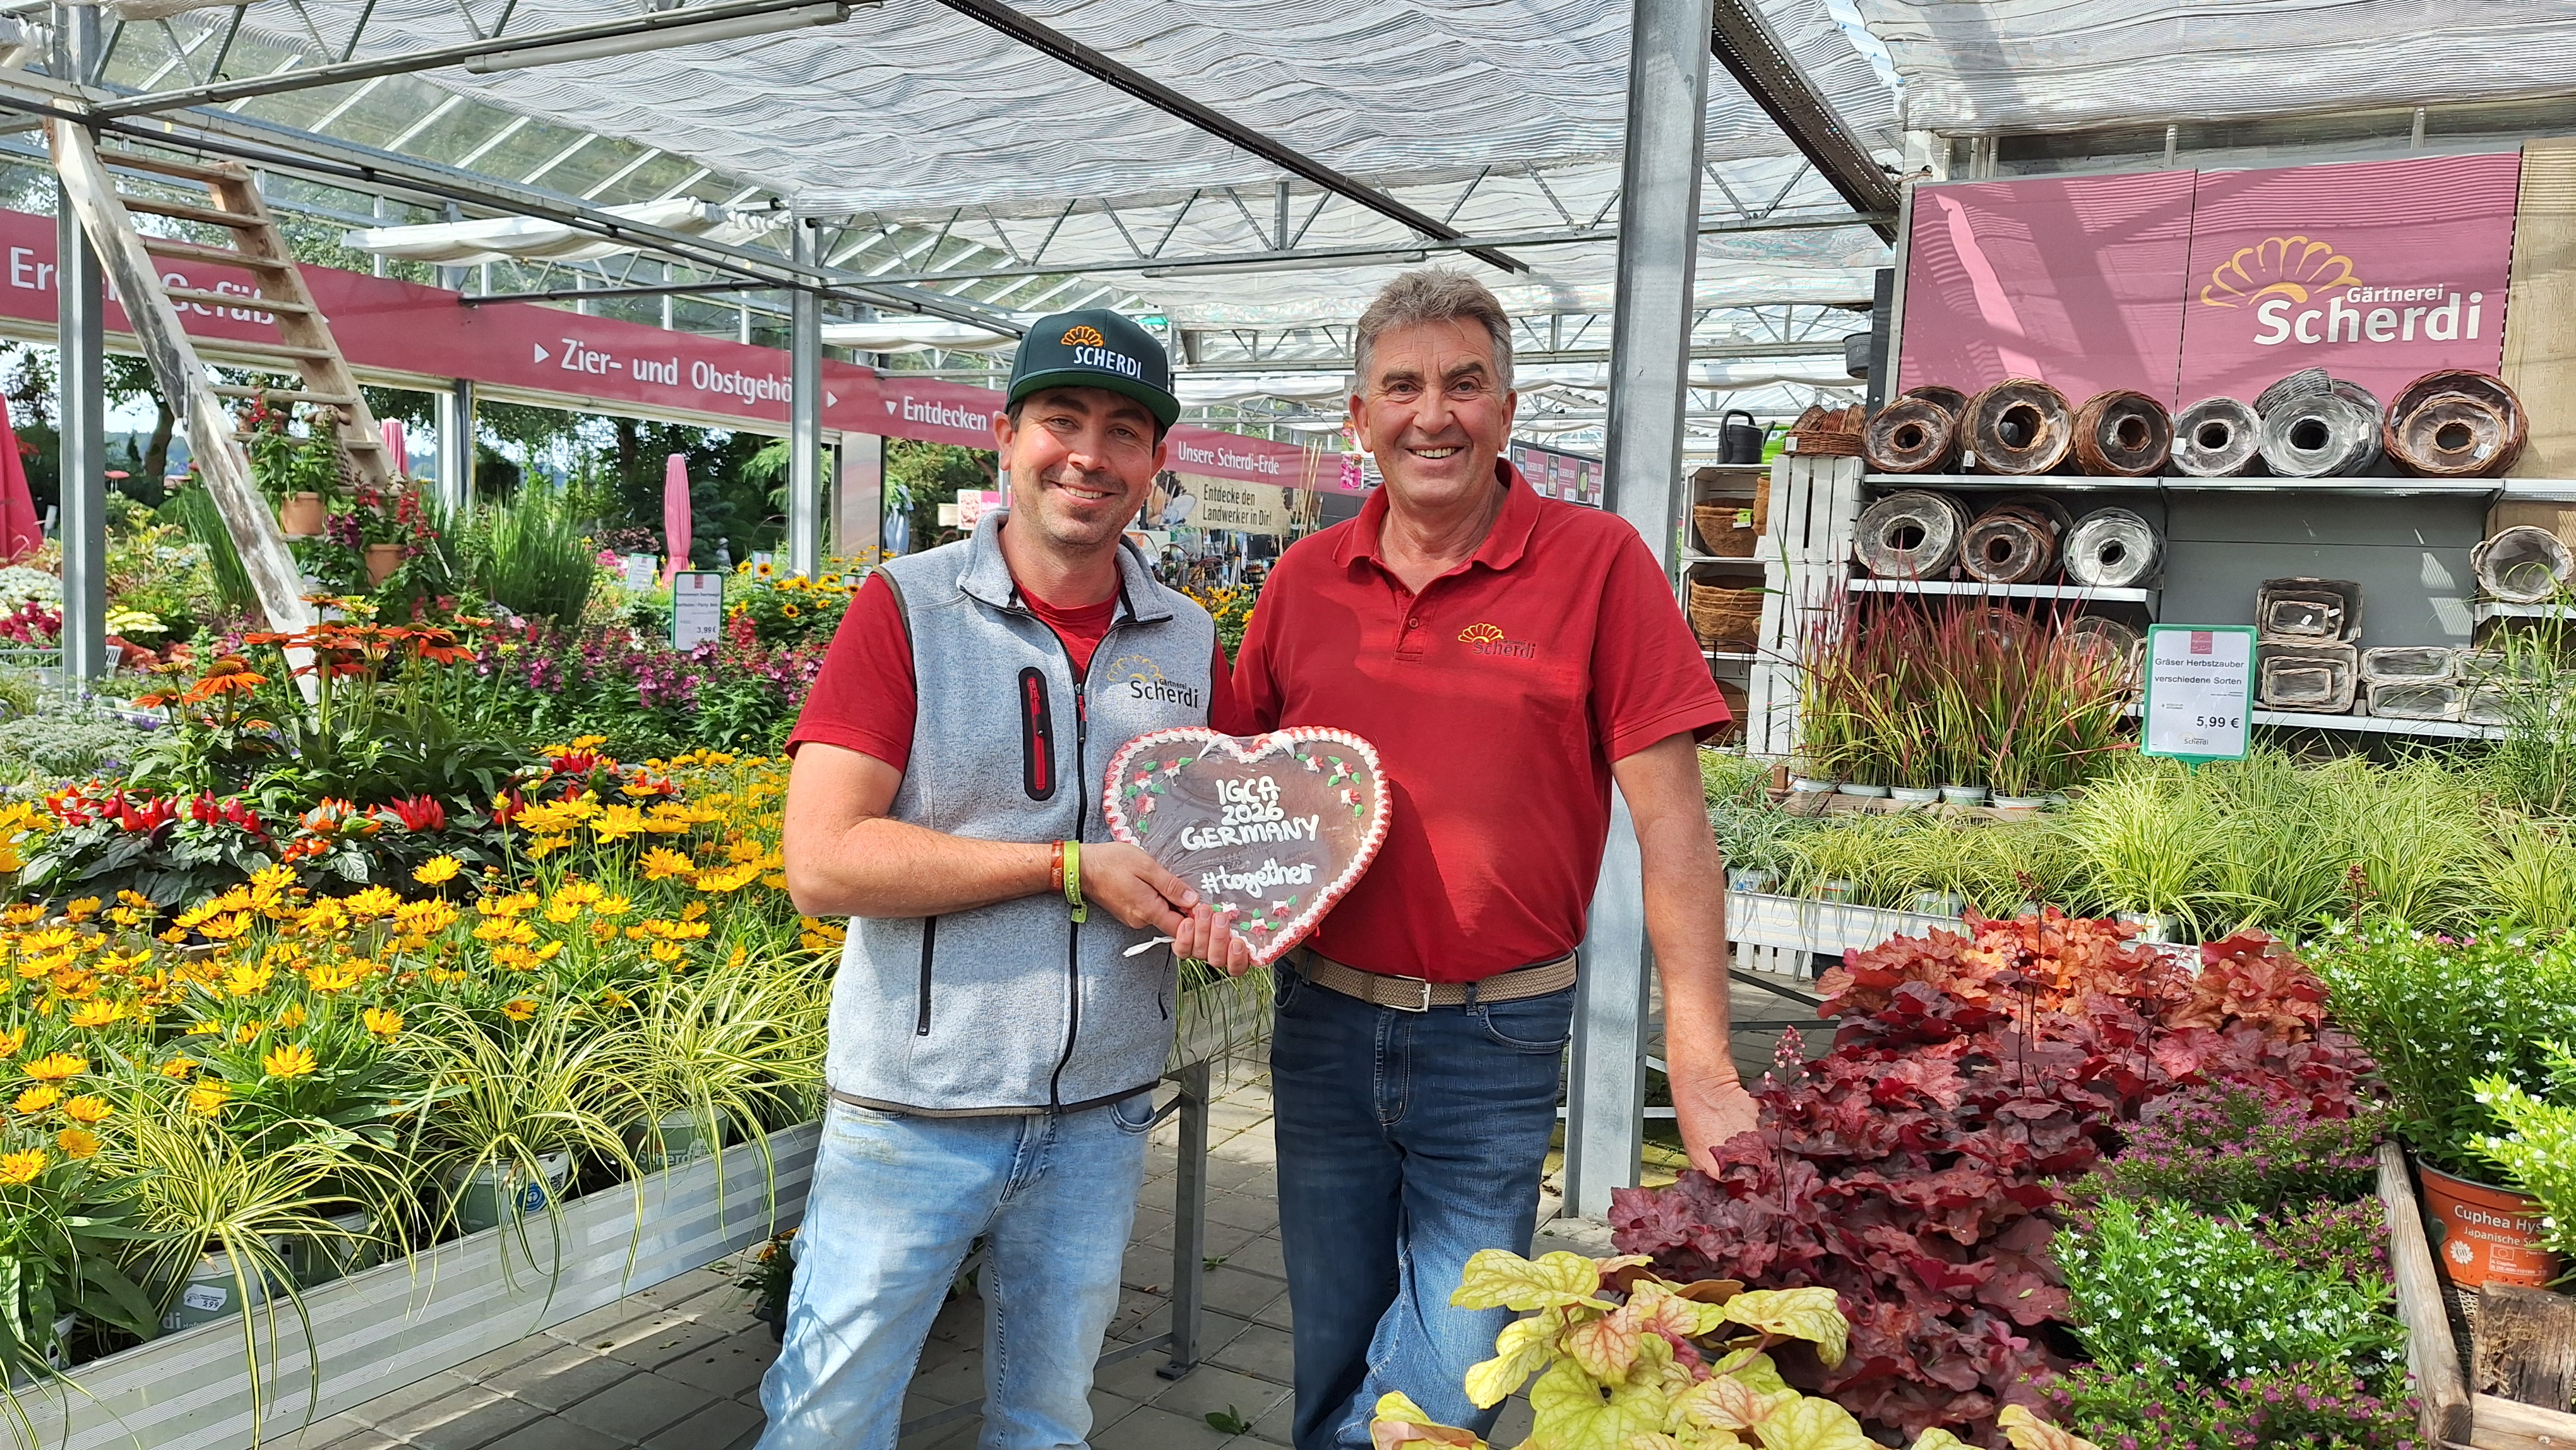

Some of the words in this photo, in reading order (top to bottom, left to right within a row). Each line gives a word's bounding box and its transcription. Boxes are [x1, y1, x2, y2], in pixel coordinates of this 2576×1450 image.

[2346, 283, 2444, 304] Gärtnerei
[2253, 291, 2483, 345] Scherdi
[561, 338, 623, 375] Zier-
[633, 357, 677, 385] und
[692, 360, 792, 405] Obstgehö
[1073, 345, 1142, 379] SCHERDI
[903, 395, 987, 431] Entdecken
[1178, 440, 1214, 465] Unsere
[1217, 447, 1279, 475] Scherdi-Erde
[1204, 484, 1239, 505] Entdecke
[1242, 489, 1255, 506] den
[1203, 503, 1249, 524] Landwerker
[1251, 510, 1257, 525] in
[1259, 510, 1272, 527] Dir!
[1472, 639, 1536, 659] Scherdi
[2155, 658, 2184, 666] Gräser
[2186, 659, 2245, 668] Herbstzauber
[2155, 675, 2210, 684] verschiedene
[2214, 677, 2241, 685] Sorten
[1130, 680, 1198, 708] Scherdi
[2196, 716, 2226, 729] 5,99
[2231, 717, 2239, 728] €
[1215, 776, 1282, 805] IGCA
[1221, 800, 1285, 825] 2026
[1181, 814, 1320, 851] GERMANY
[1200, 858, 1316, 899] #together
[2454, 1204, 2510, 1229] Cuphea
[2464, 1226, 2520, 1245] Japanische
